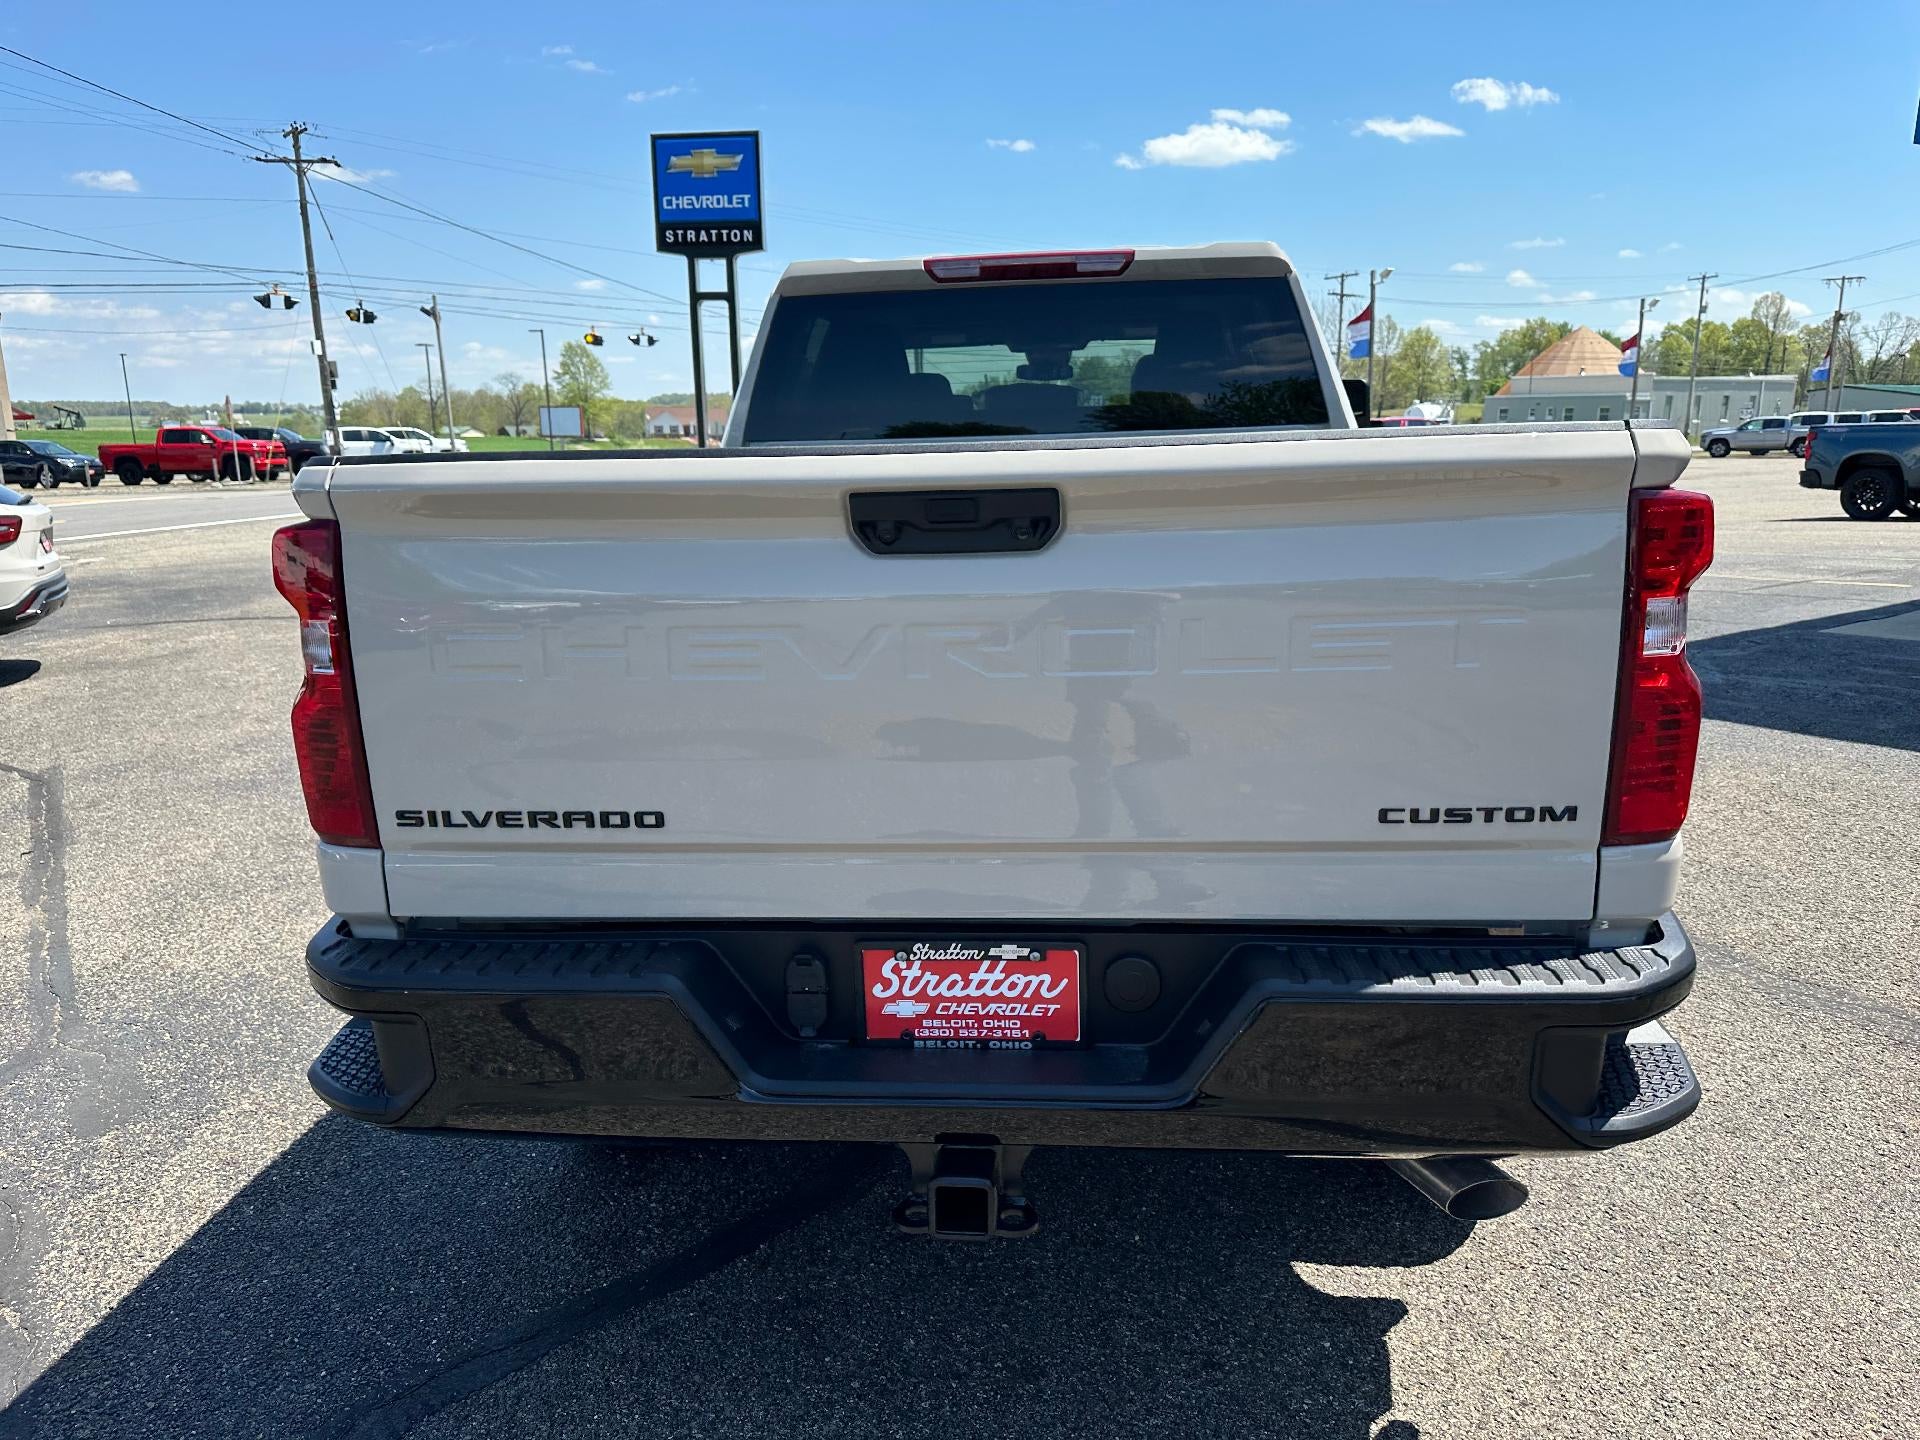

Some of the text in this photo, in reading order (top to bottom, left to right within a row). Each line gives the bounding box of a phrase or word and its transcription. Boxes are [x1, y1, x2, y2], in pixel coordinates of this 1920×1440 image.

[662, 194, 751, 209] CHEVROLET
[665, 230, 753, 242] STRATTON
[430, 608, 1527, 681] CHEVROLET
[396, 809, 666, 829] SILVERADO
[1378, 805, 1579, 824] CUSTOM
[910, 943, 984, 960] Stratton
[872, 957, 1068, 999] Stratton
[935, 1002, 1060, 1017] CHEVROLET
[922, 1019, 1020, 1028] BELOIT, OHIO
[914, 1028, 1029, 1038] (330) 537-3151
[988, 1040, 1033, 1050] OHIO
